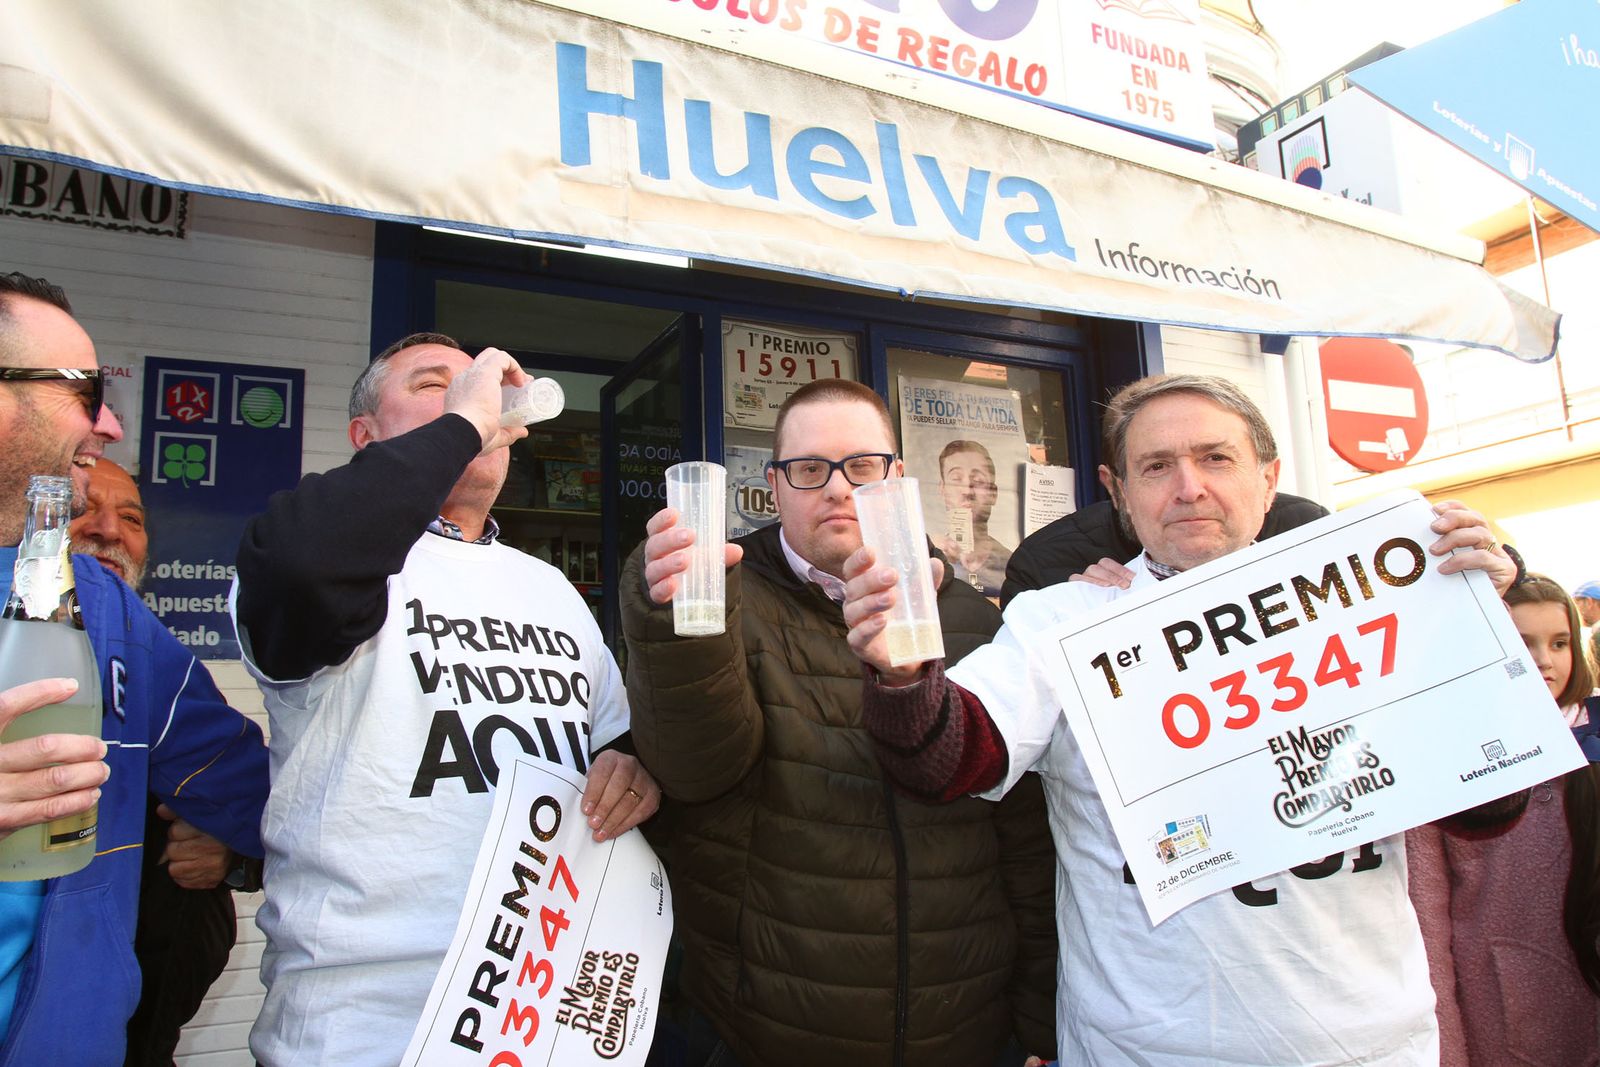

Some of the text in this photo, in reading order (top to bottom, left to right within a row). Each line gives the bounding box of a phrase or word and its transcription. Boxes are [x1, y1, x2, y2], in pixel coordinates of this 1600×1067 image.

[823, 7, 881, 53] DE
[898, 26, 1049, 97] REGALO
[1091, 21, 1192, 74] FUNDADA
[1130, 63, 1160, 91] EN
[1121, 88, 1177, 123] 1975
[555, 41, 1077, 262] Huelva
[0, 160, 173, 225] BANO
[1536, 167, 1598, 212] Apuestas
[1094, 237, 1282, 300] Información
[762, 334, 831, 356] PREMIO
[904, 397, 1017, 425] DE TODA LA VIDA
[914, 388, 937, 400] ERES
[913, 415, 936, 424] PUEDES
[935, 417, 957, 425] SELLAR
[151, 559, 237, 580] oterías
[1090, 536, 1427, 699] 1er PREMIO
[1161, 612, 1400, 749] 03347
[1267, 724, 1360, 766] EL MAYOR
[1354, 741, 1380, 769] ES
[1497, 745, 1543, 771] Nacional
[1273, 767, 1396, 829] COMPARTIRLO
[1344, 810, 1375, 827] Cobano
[1331, 824, 1359, 838] Huelva
[1156, 851, 1235, 892] 22 de DICIEMBRE
[450, 794, 562, 1054] PREMIO
[555, 950, 600, 1026] EL MAYOR
[571, 950, 624, 1036] PREMIO ES
[593, 952, 640, 1060] COMPARTIRLO
